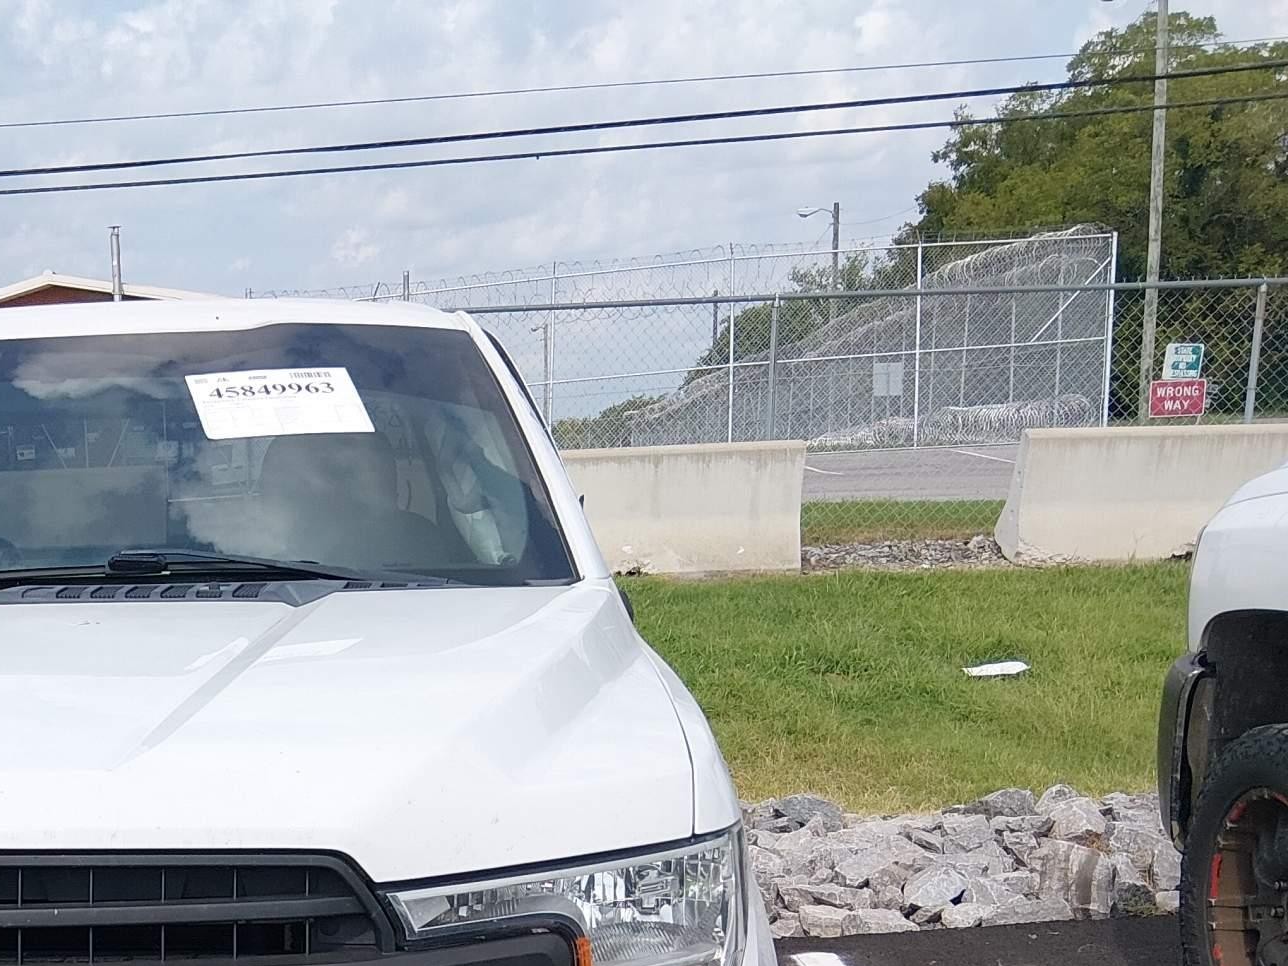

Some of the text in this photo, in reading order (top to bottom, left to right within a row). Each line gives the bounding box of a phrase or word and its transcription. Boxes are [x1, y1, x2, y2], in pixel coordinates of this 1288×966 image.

[209, 381, 335, 399] 45849963
[1156, 386, 1199, 398] WRONG
[1164, 399, 1190, 411] WAY
